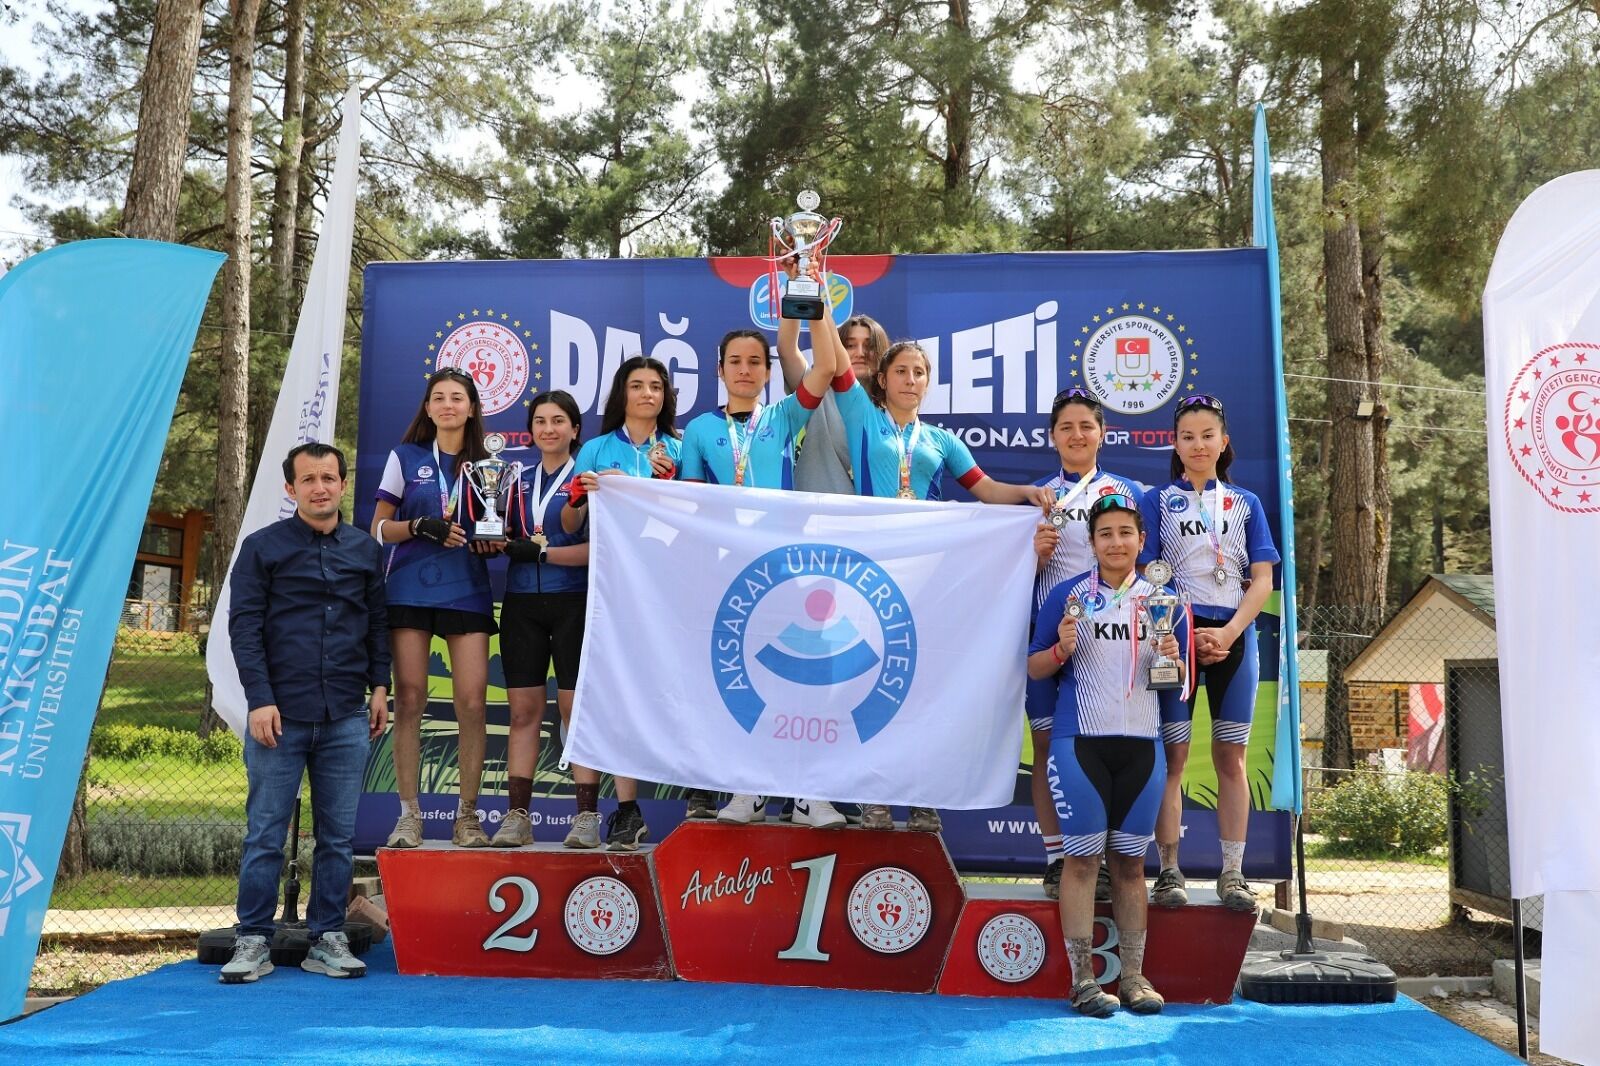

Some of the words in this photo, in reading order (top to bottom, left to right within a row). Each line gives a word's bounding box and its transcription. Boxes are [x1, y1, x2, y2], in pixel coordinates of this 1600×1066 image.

[1087, 323, 1123, 363] ÜNİVERSİTE
[1125, 321, 1168, 341] SPORLARI
[550, 309, 699, 416] DAĞ
[1088, 366, 1110, 400] TÜRKİYE
[1157, 340, 1178, 400] FEDERASYONU
[1122, 400, 1145, 409] 1996
[1535, 375, 1564, 441] CUMHURİYETİ
[1539, 442, 1569, 480] TÜRKİYE
[717, 561, 774, 691] AKSARAY
[786, 546, 912, 705] ÜNİVERSİTESİ
[18, 606, 84, 780] ÜNİVERSİTESİ
[773, 713, 839, 745] 2006
[419, 809, 455, 820] usfed
[1046, 755, 1073, 820] KMÜ
[680, 857, 774, 910] Antalya
[777, 853, 837, 962] 1
[482, 875, 540, 952] 2
